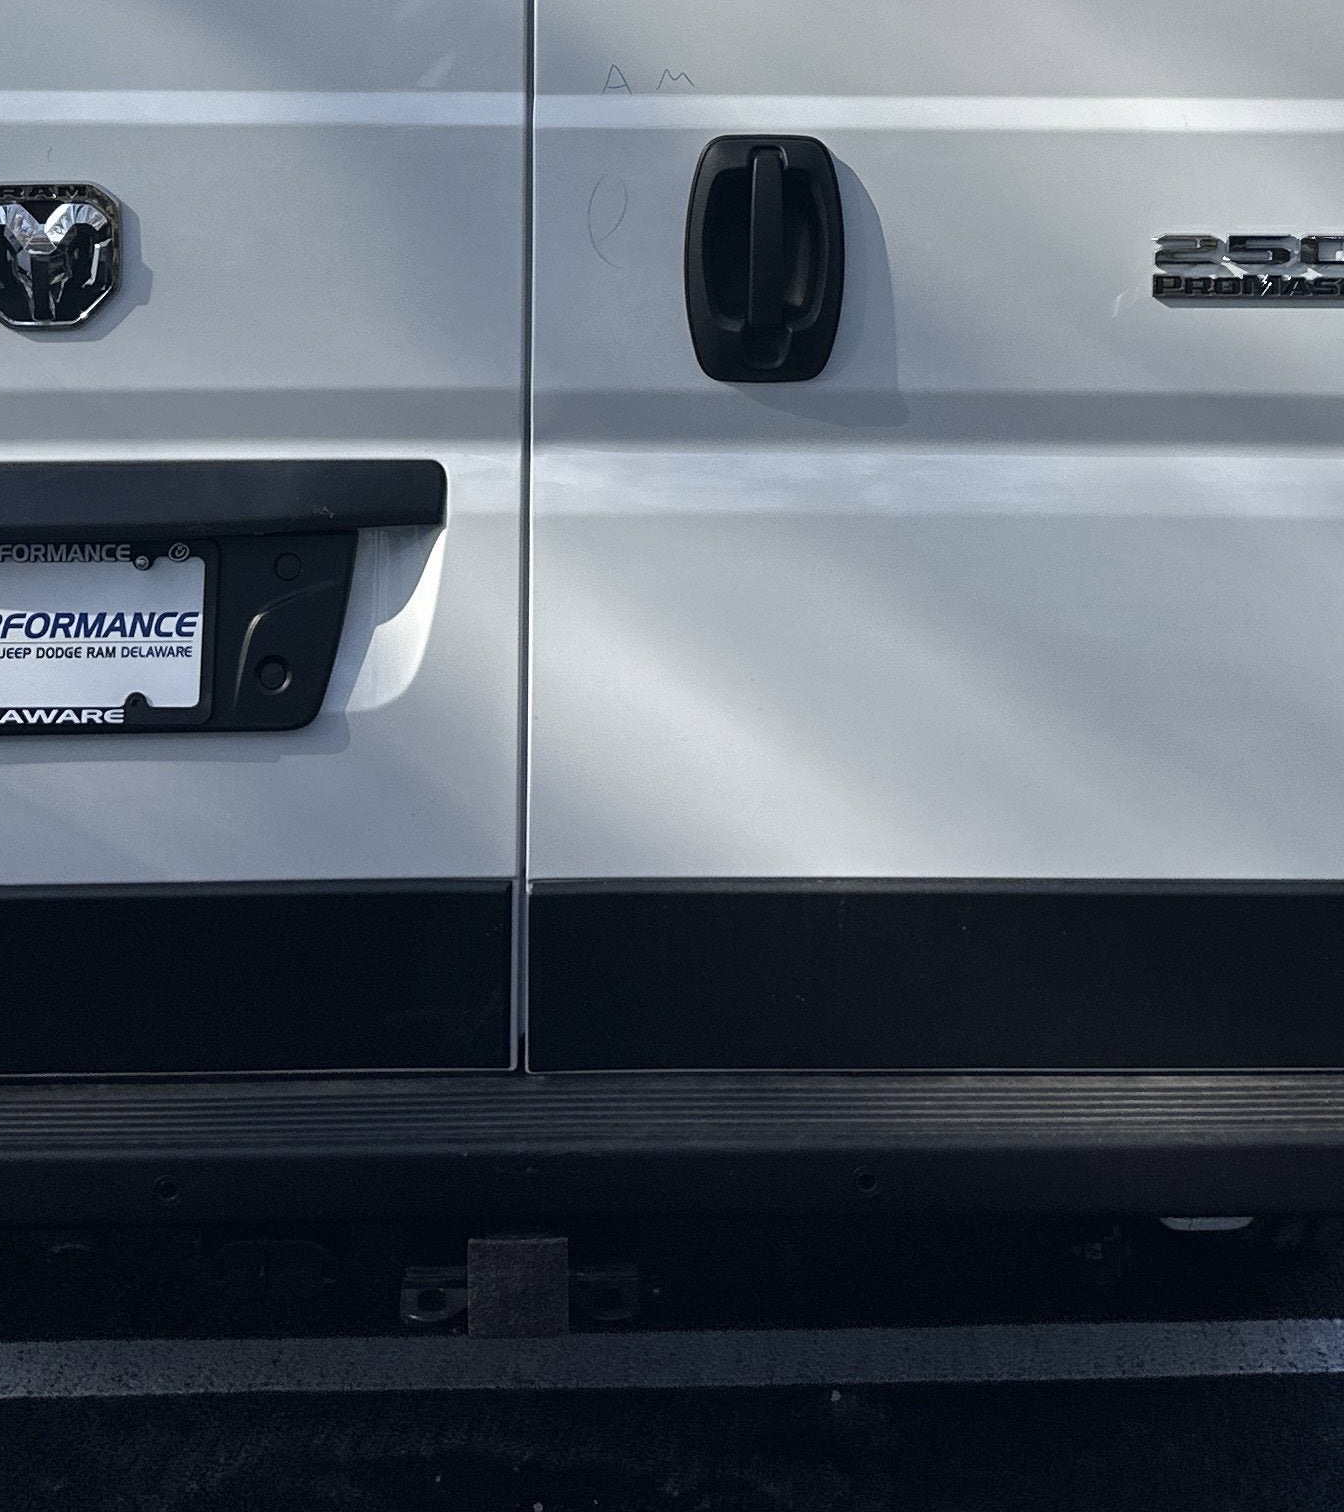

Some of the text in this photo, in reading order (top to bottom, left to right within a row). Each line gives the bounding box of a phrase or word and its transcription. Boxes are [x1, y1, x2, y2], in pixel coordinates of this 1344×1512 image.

[36, 646, 83, 659] DODGE
[86, 646, 116, 659] RAM
[120, 645, 193, 658] DELAWARE
